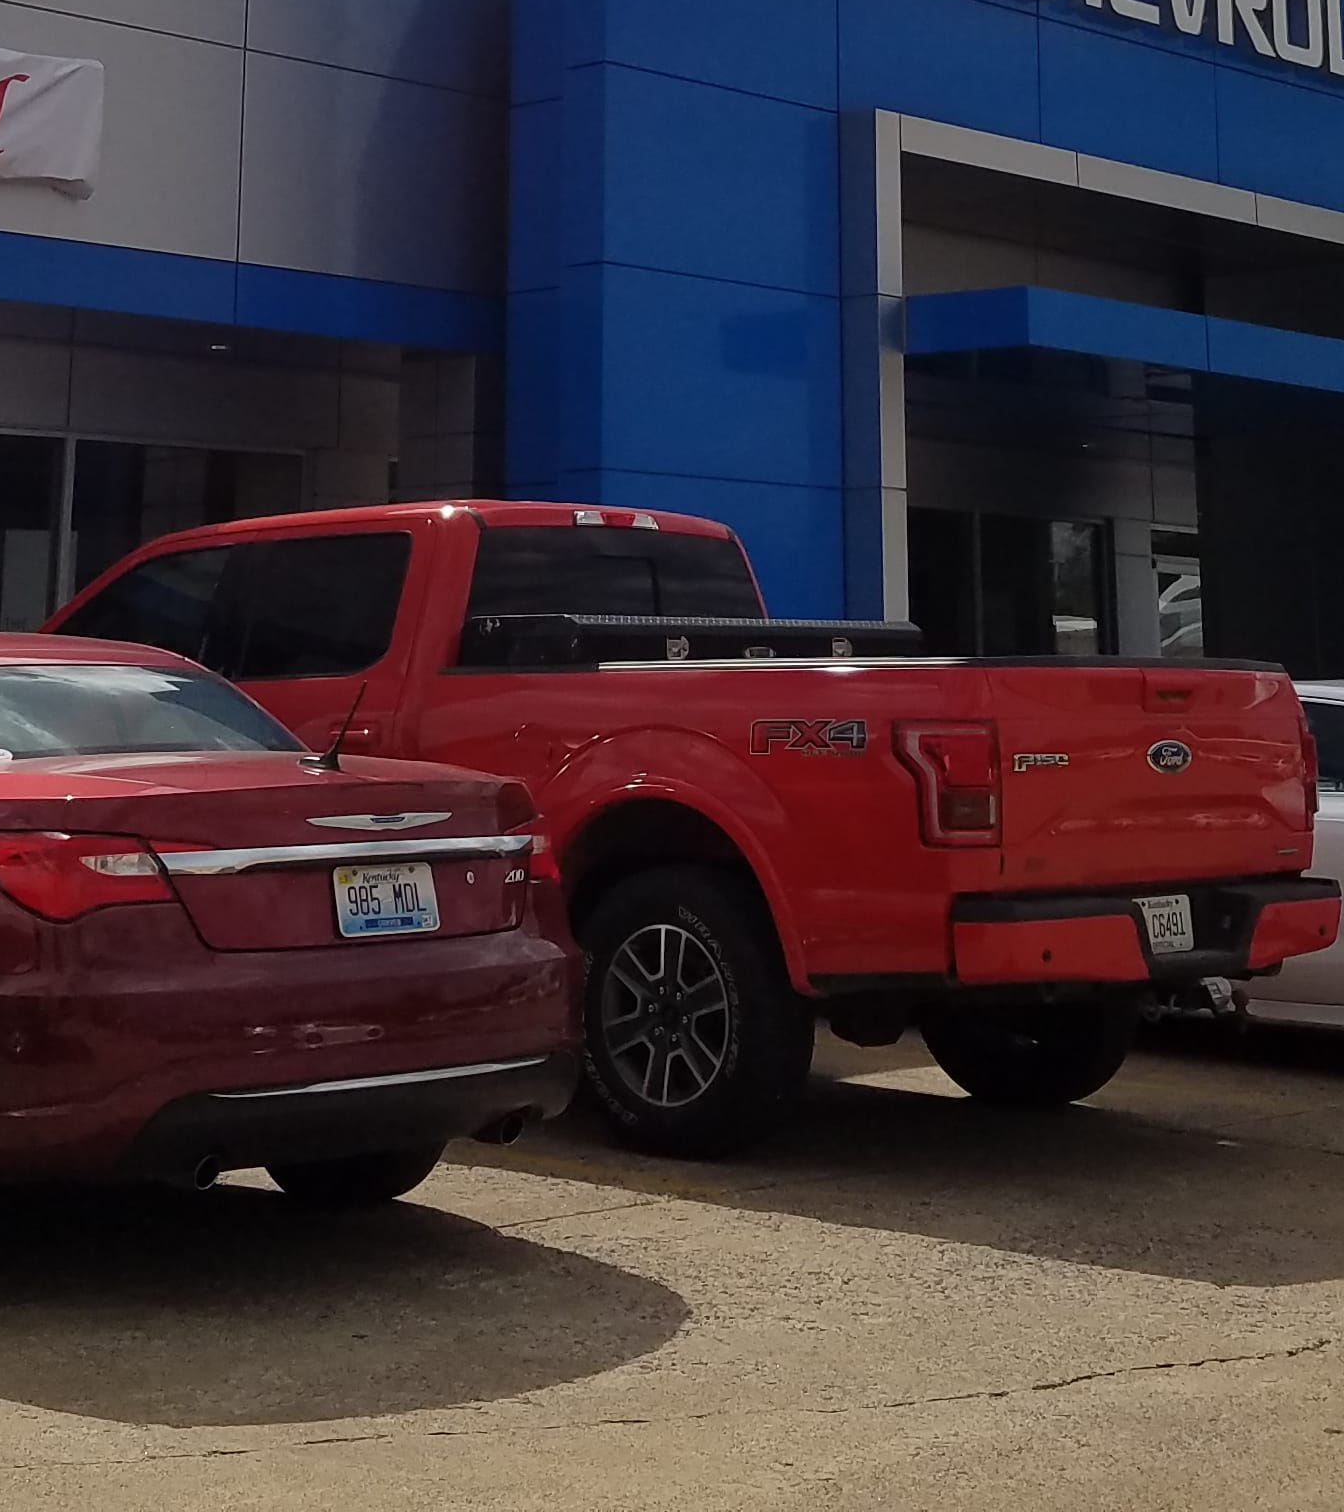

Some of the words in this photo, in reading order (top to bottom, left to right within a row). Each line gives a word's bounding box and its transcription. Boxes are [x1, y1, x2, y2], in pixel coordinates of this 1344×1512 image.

[749, 718, 868, 755] FX4
[362, 871, 401, 884] Kentucky
[347, 884, 382, 916] 985
[392, 882, 428, 915] MDL
[1151, 911, 1186, 939] C6491
